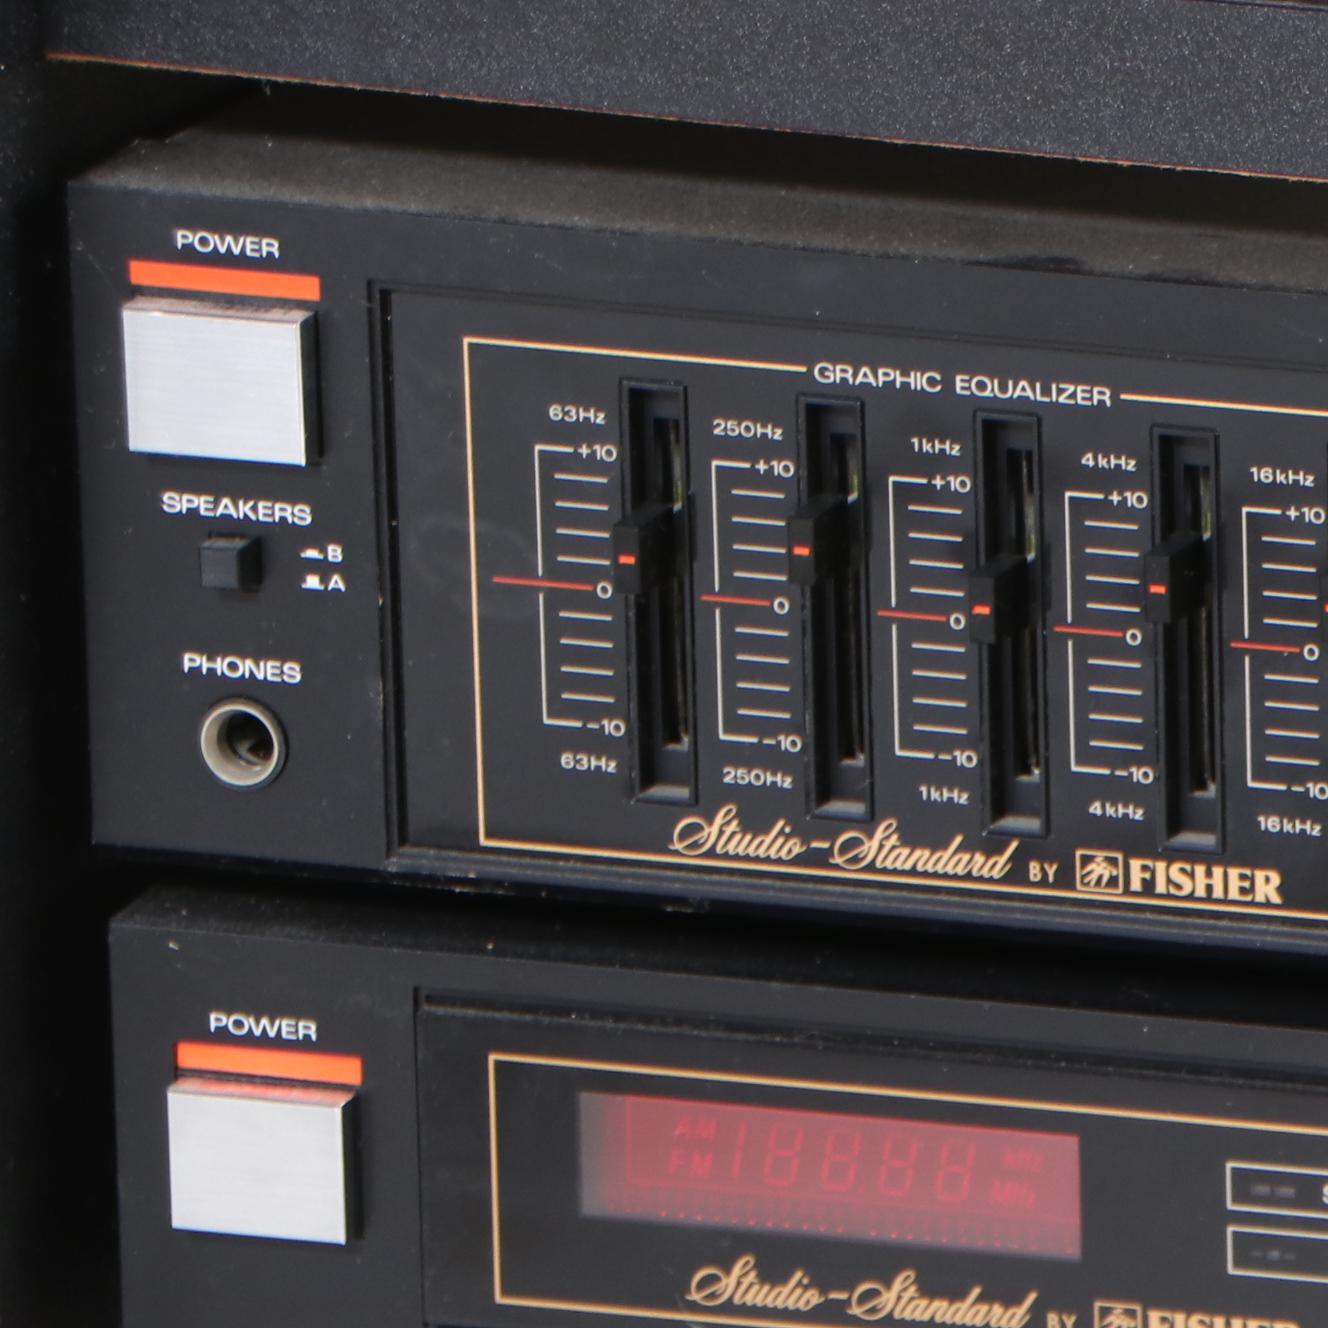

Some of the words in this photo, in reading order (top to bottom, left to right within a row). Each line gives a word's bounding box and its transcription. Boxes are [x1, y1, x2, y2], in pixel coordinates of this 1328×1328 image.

[176, 231, 280, 258] POWER
[813, 362, 942, 394] GRAPHIC
[955, 373, 1111, 408] EQUALIZER
[548, 405, 606, 425] 63Hz
[712, 420, 784, 441] 250Hz
[578, 443, 617, 464] +10
[910, 436, 962, 458] 1kHz
[755, 458, 794, 478] +10
[1081, 451, 1137, 474] 4kHz
[931, 475, 971, 494] +10
[1250, 466, 1316, 488] 16kHz
[162, 492, 312, 525] SPEAKERS
[1108, 490, 1149, 510] +10
[1286, 505, 1326, 526] +10
[327, 546, 342, 563] B
[327, 573, 345, 592] A
[183, 653, 302, 684] PHONES
[560, 752, 617, 774] 63Hz
[722, 767, 793, 790] 250Hz
[919, 785, 969, 807] 1kHz
[1088, 800, 1145, 823] 4kHz
[1257, 815, 1323, 838] 16kHz
[671, 803, 1018, 882] Studio-Standard
[1029, 861, 1058, 883] BY
[1129, 857, 1282, 904] FISHER
[209, 1012, 317, 1042] POWER
